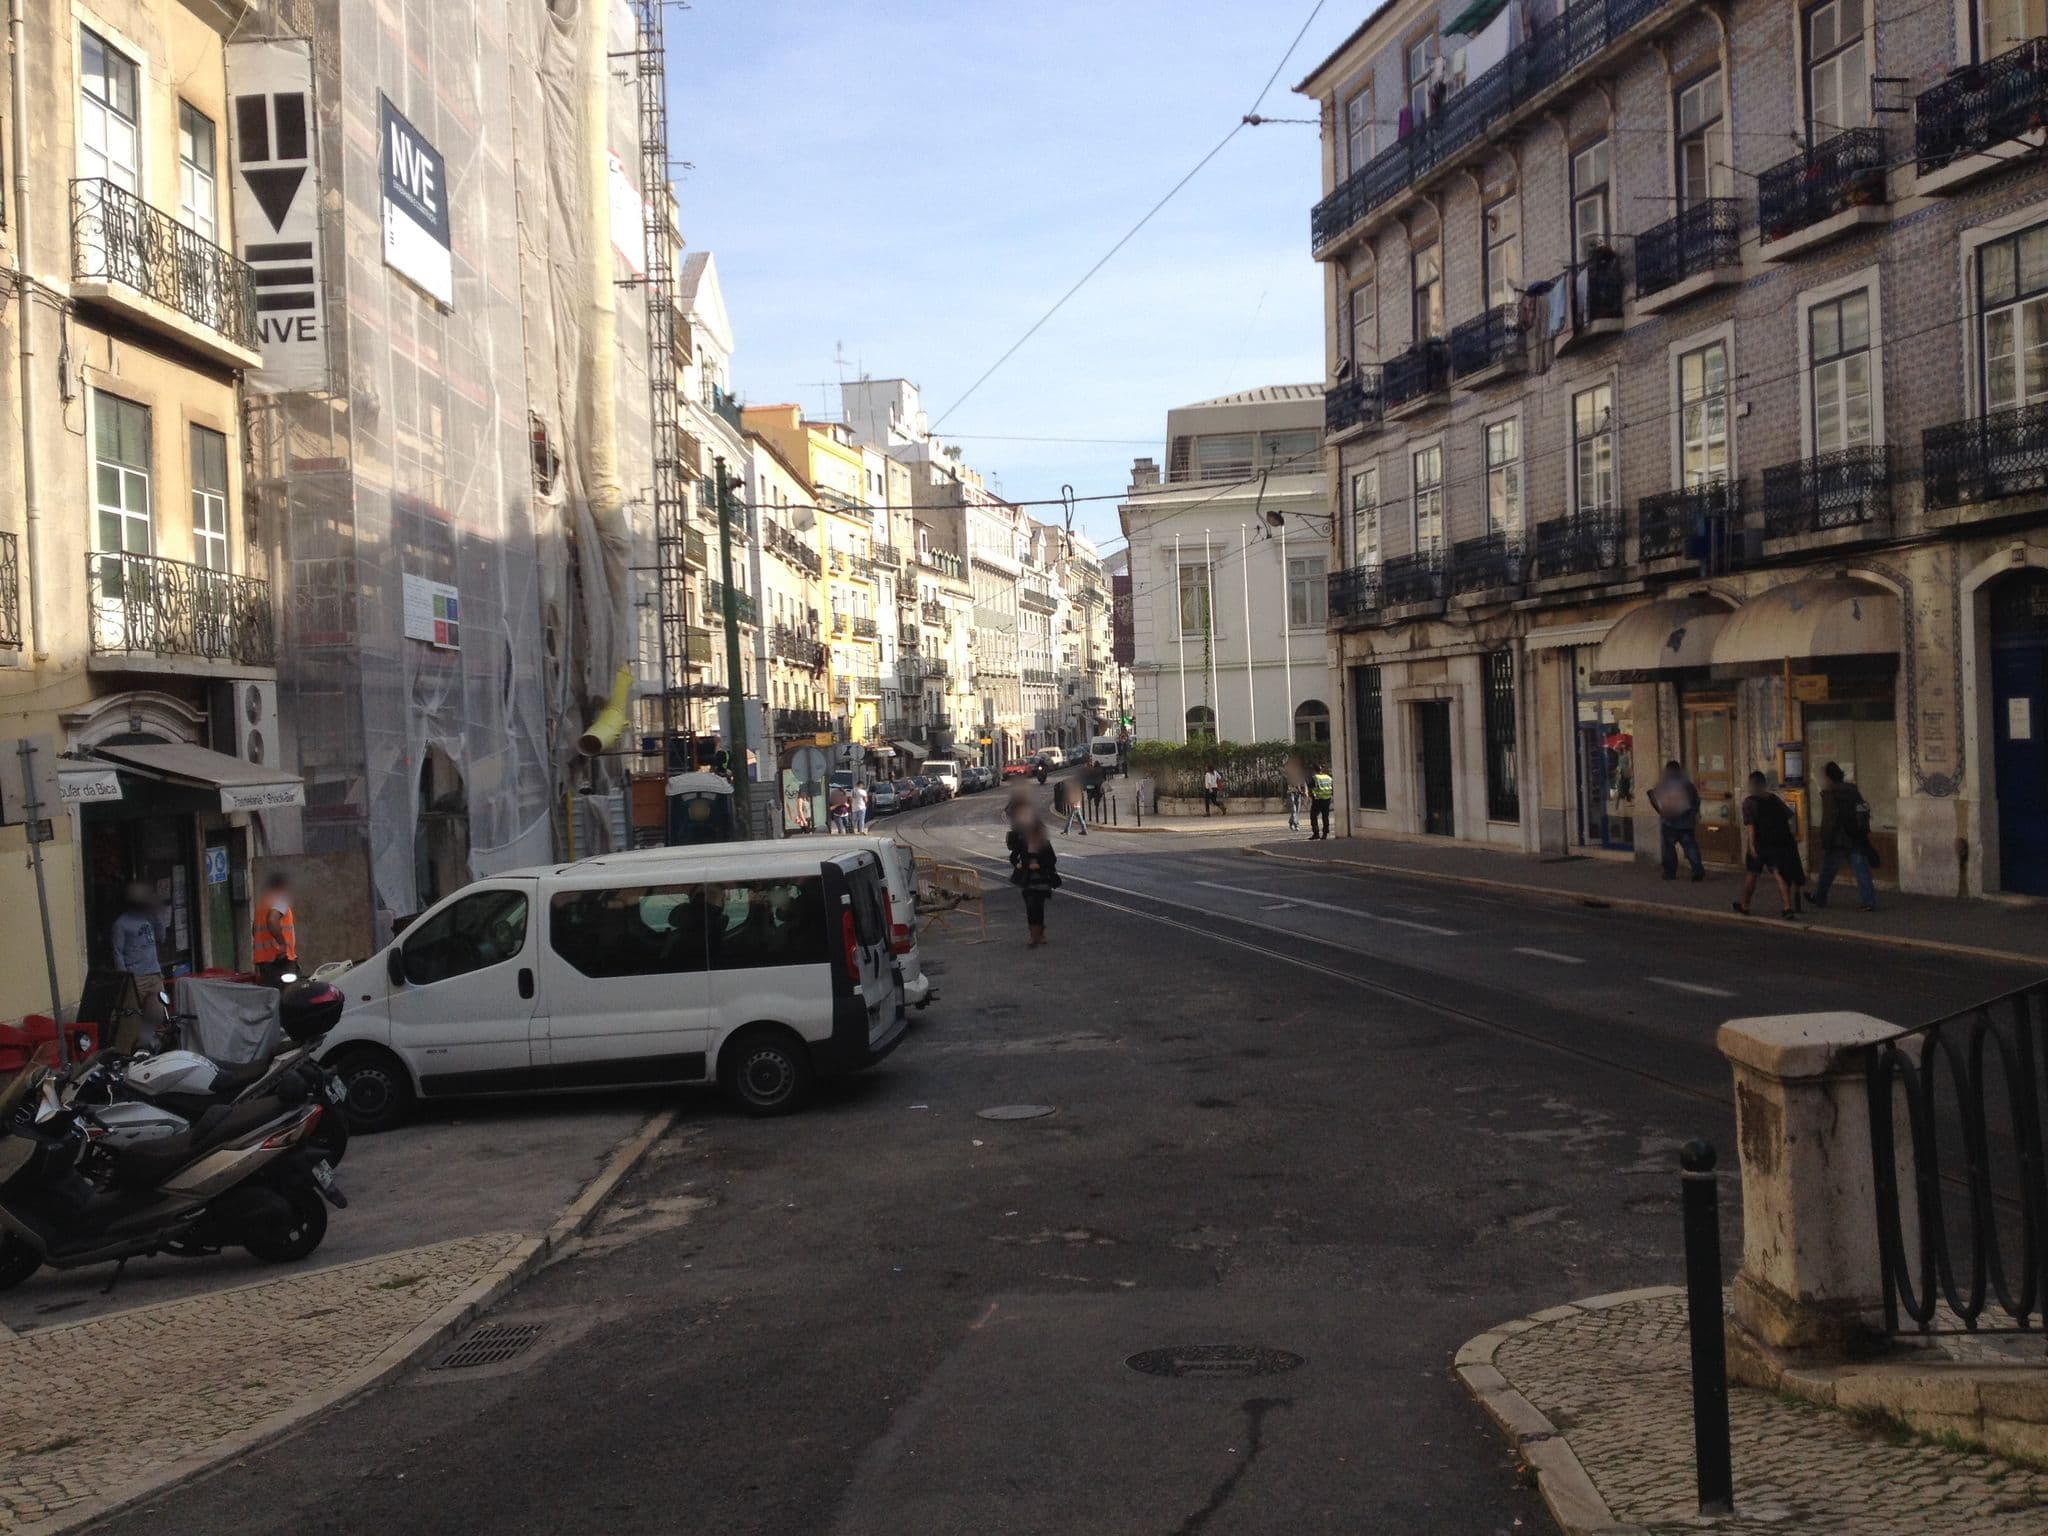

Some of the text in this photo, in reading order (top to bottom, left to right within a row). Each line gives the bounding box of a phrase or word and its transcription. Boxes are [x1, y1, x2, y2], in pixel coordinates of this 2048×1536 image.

[391, 121, 437, 213] NVE
[83, 784, 96, 796] da
[95, 783, 117, 795] Bica
